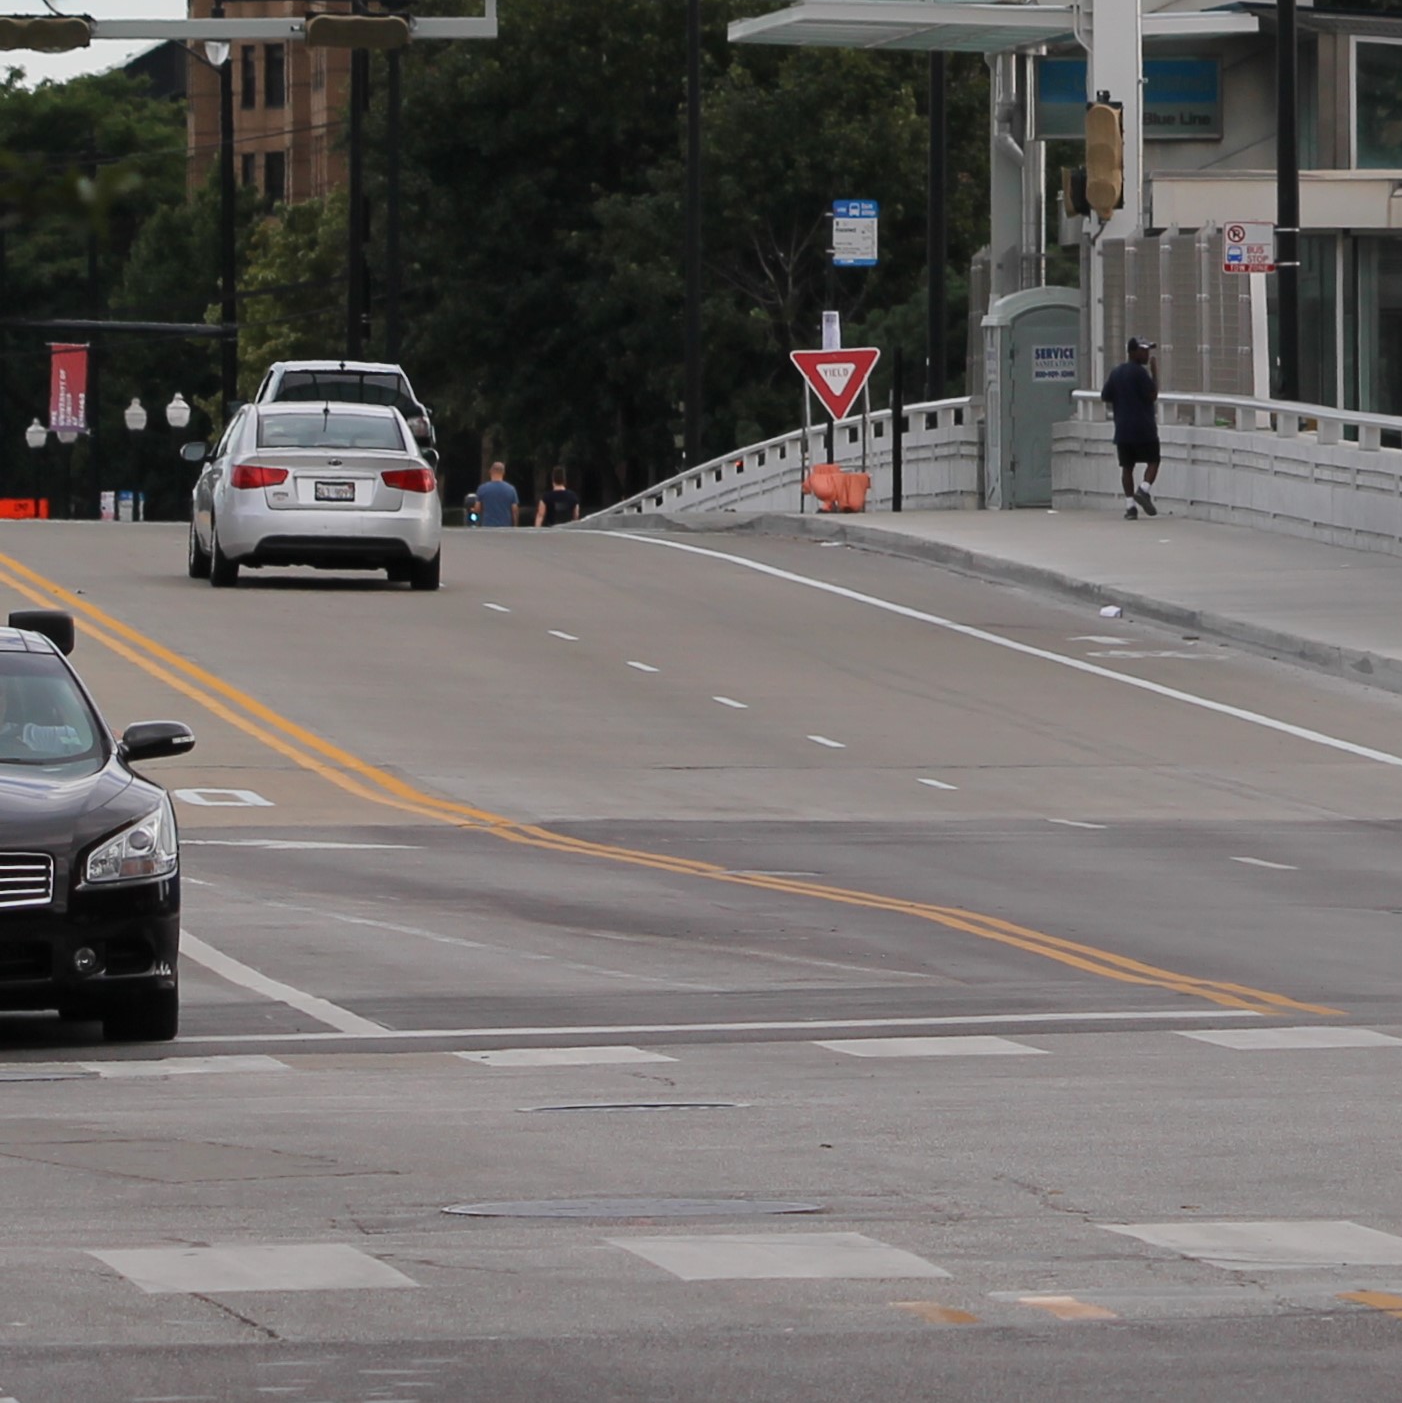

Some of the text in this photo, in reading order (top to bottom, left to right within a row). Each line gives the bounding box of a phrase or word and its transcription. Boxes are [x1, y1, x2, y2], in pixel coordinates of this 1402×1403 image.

[1179, 111, 1211, 126] Line
[1247, 246, 1264, 254] BUS
[1247, 255, 1269, 263] STOP
[1035, 348, 1074, 359] SERVICE
[823, 368, 849, 377] YIELD
